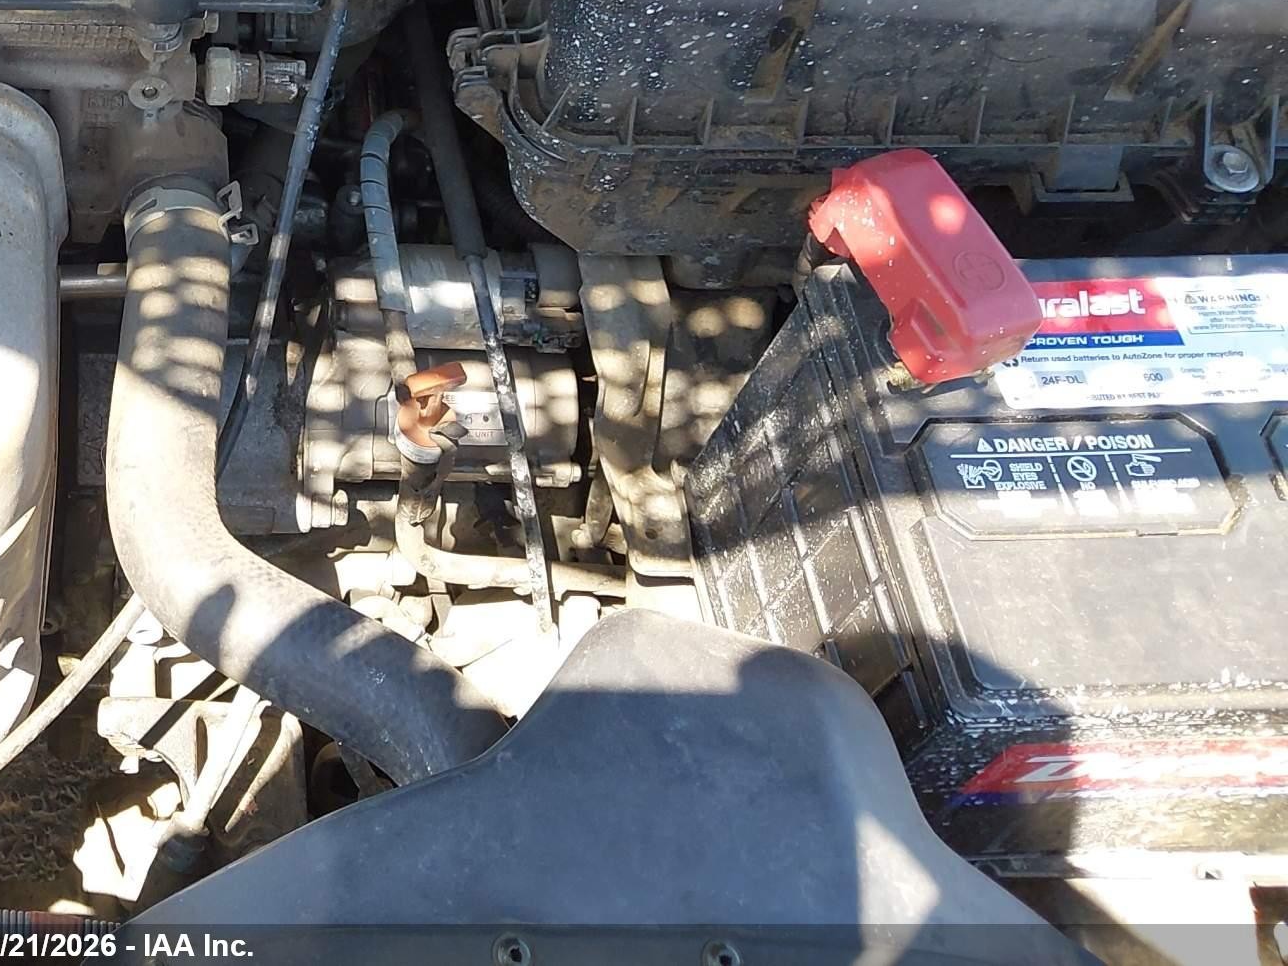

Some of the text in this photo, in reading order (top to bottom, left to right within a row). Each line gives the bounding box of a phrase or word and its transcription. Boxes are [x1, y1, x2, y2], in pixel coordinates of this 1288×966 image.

[1027, 334, 1144, 346] PROVEN TOUGH
[1020, 349, 1244, 363] Return used batteries to AutoZone for proper recycling
[1041, 375, 1083, 386] 24F-DL
[993, 436, 1070, 453] DANGER
[1084, 434, 1155, 451] POISON
[1009, 462, 1044, 472] SHIELD
[1012, 472, 1038, 481] EYES
[994, 480, 1047, 491] EXPLOSIVE
[1079, 481, 1096, 491] NO
